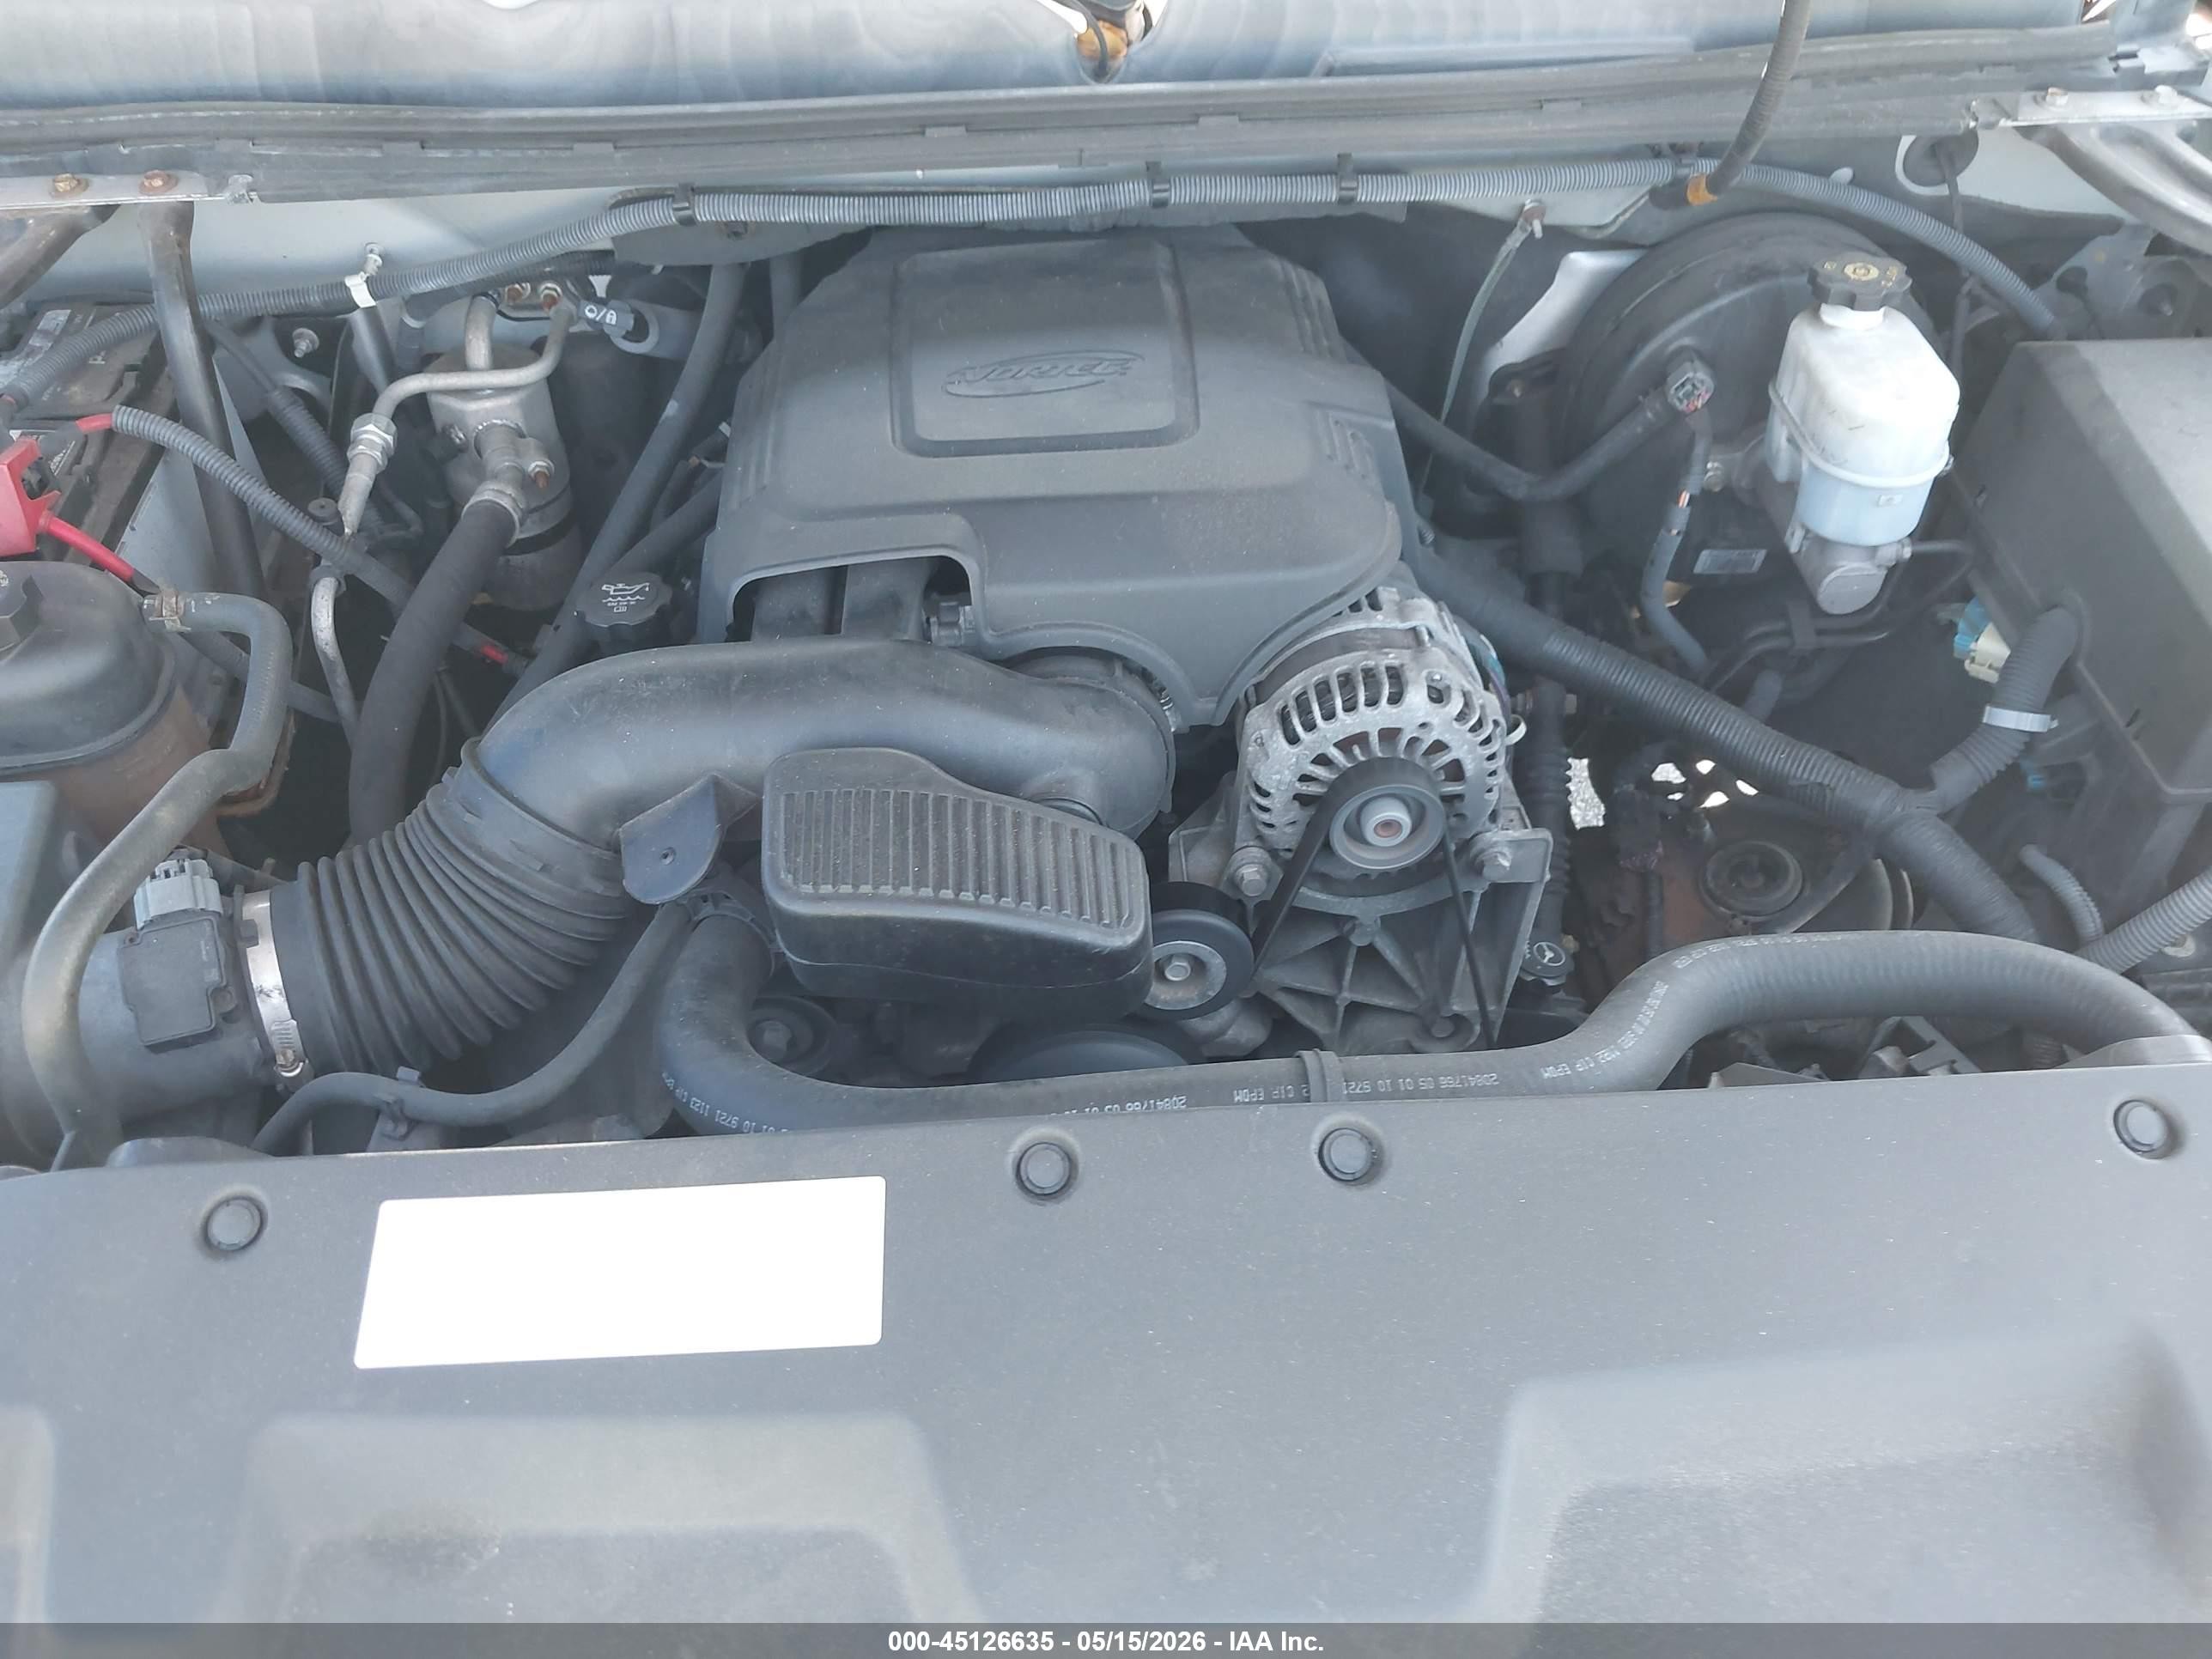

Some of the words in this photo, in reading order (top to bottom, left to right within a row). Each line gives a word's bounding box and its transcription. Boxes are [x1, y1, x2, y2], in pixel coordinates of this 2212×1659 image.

[1376, 1079, 1393, 1093] 10
[1397, 1079, 1414, 1091] 01
[714, 1109, 739, 1129] 9721
[742, 1121, 757, 1133] 10
